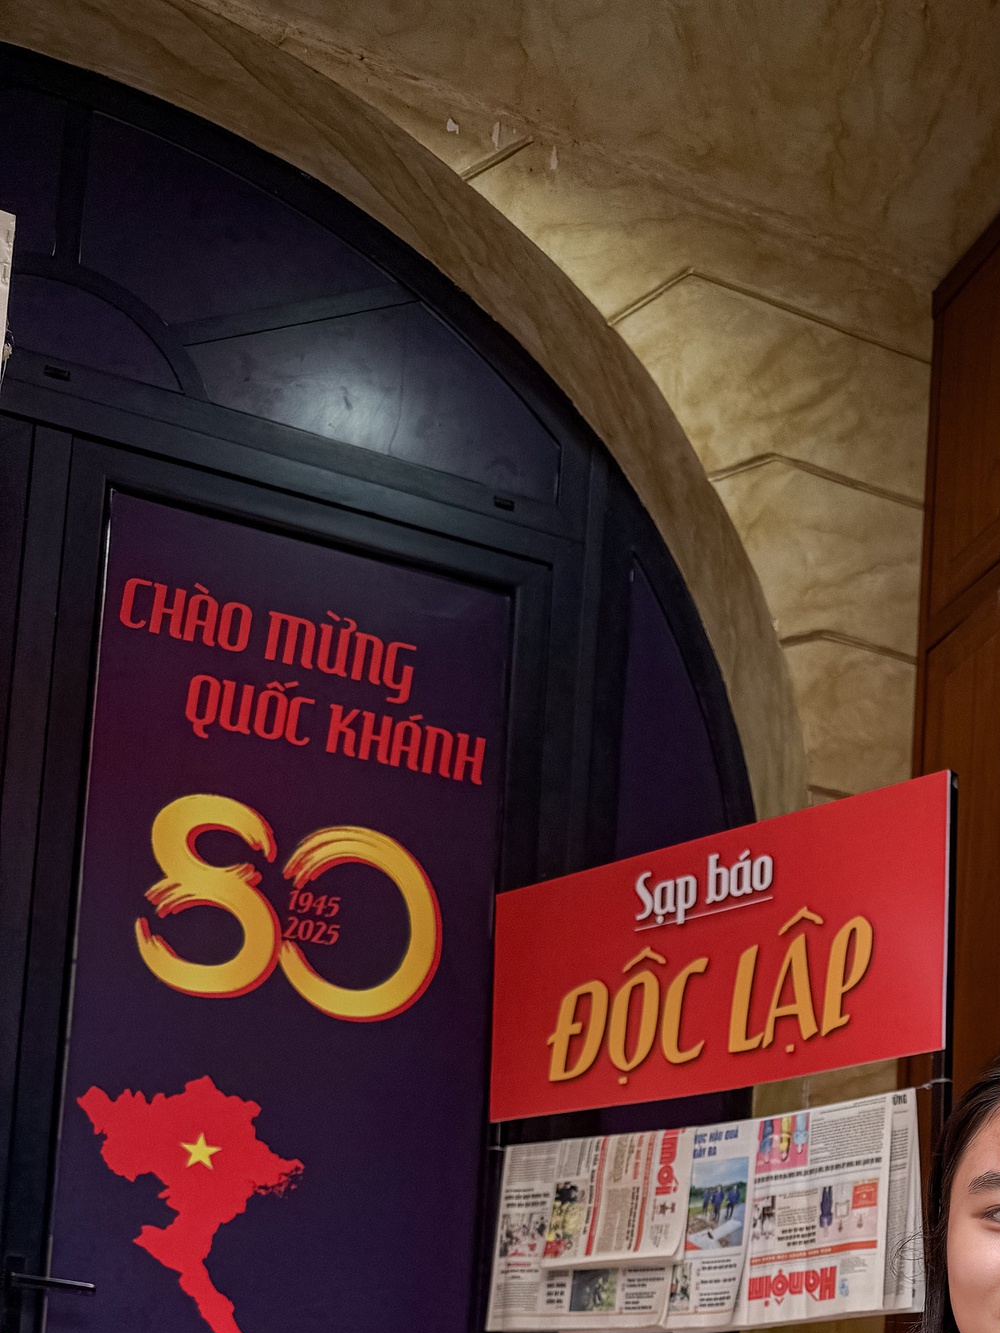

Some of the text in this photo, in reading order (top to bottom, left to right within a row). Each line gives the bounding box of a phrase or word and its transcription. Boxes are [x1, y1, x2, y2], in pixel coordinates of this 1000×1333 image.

[119, 576, 418, 705] CHÀO MỪNG
[184, 673, 487, 786] QUỐC KHÁNH
[135, 793, 443, 1023] 80
[282, 915, 341, 946] 2025
[288, 889, 341, 917] 1945
[634, 848, 774, 925] Sạp báo
[546, 906, 874, 1086] ĐỘC LẬP
